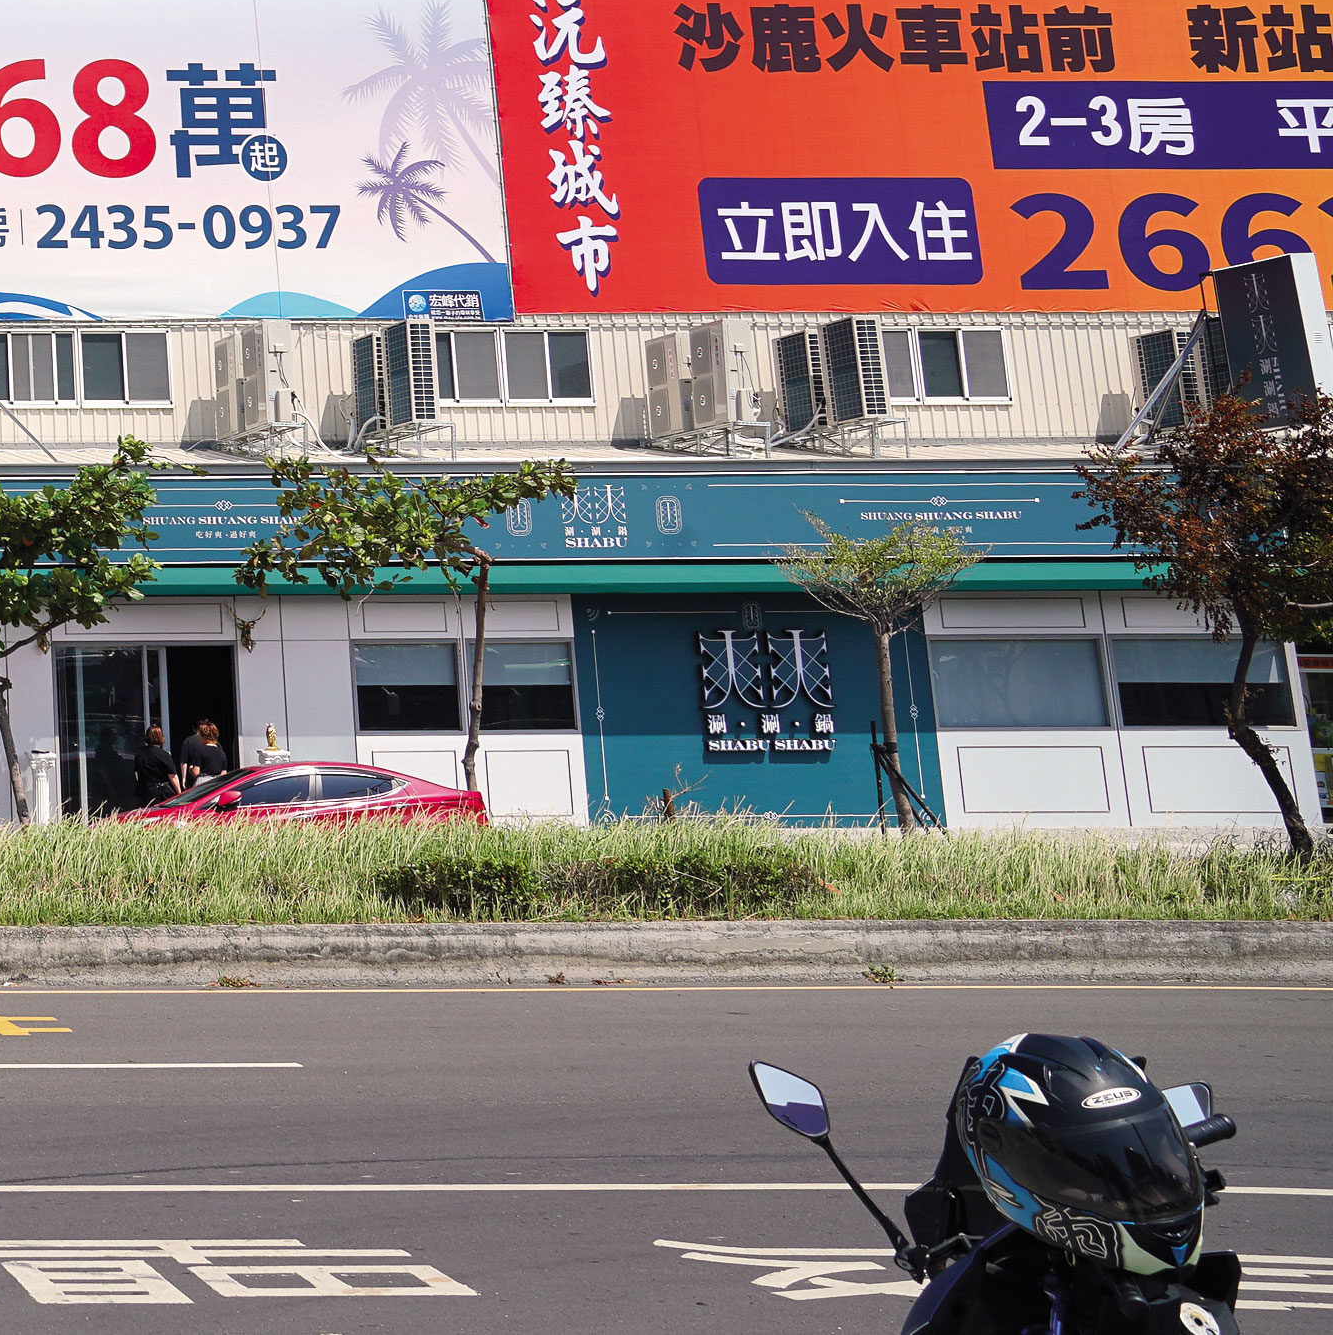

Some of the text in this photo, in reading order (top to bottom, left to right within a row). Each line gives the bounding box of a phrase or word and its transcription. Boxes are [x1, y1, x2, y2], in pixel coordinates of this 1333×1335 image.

[673, 2, 1116, 73] 沙鹿火車站前
[1015, 95, 1195, 156] 2-3房
[35, 204, 342, 250] 2435-0937
[717, 199, 974, 263] 立即入住
[1009, 191, 1333, 292] 266
[142, 515, 304, 526] SHUANG SHUANG SHAB
[860, 509, 1022, 521] SHUANG SHUANG SHABU
[565, 536, 628, 548] SHABU
[708, 739, 837, 752] SHABU SHABU
[1091, 1089, 1134, 1105] ZEUS
